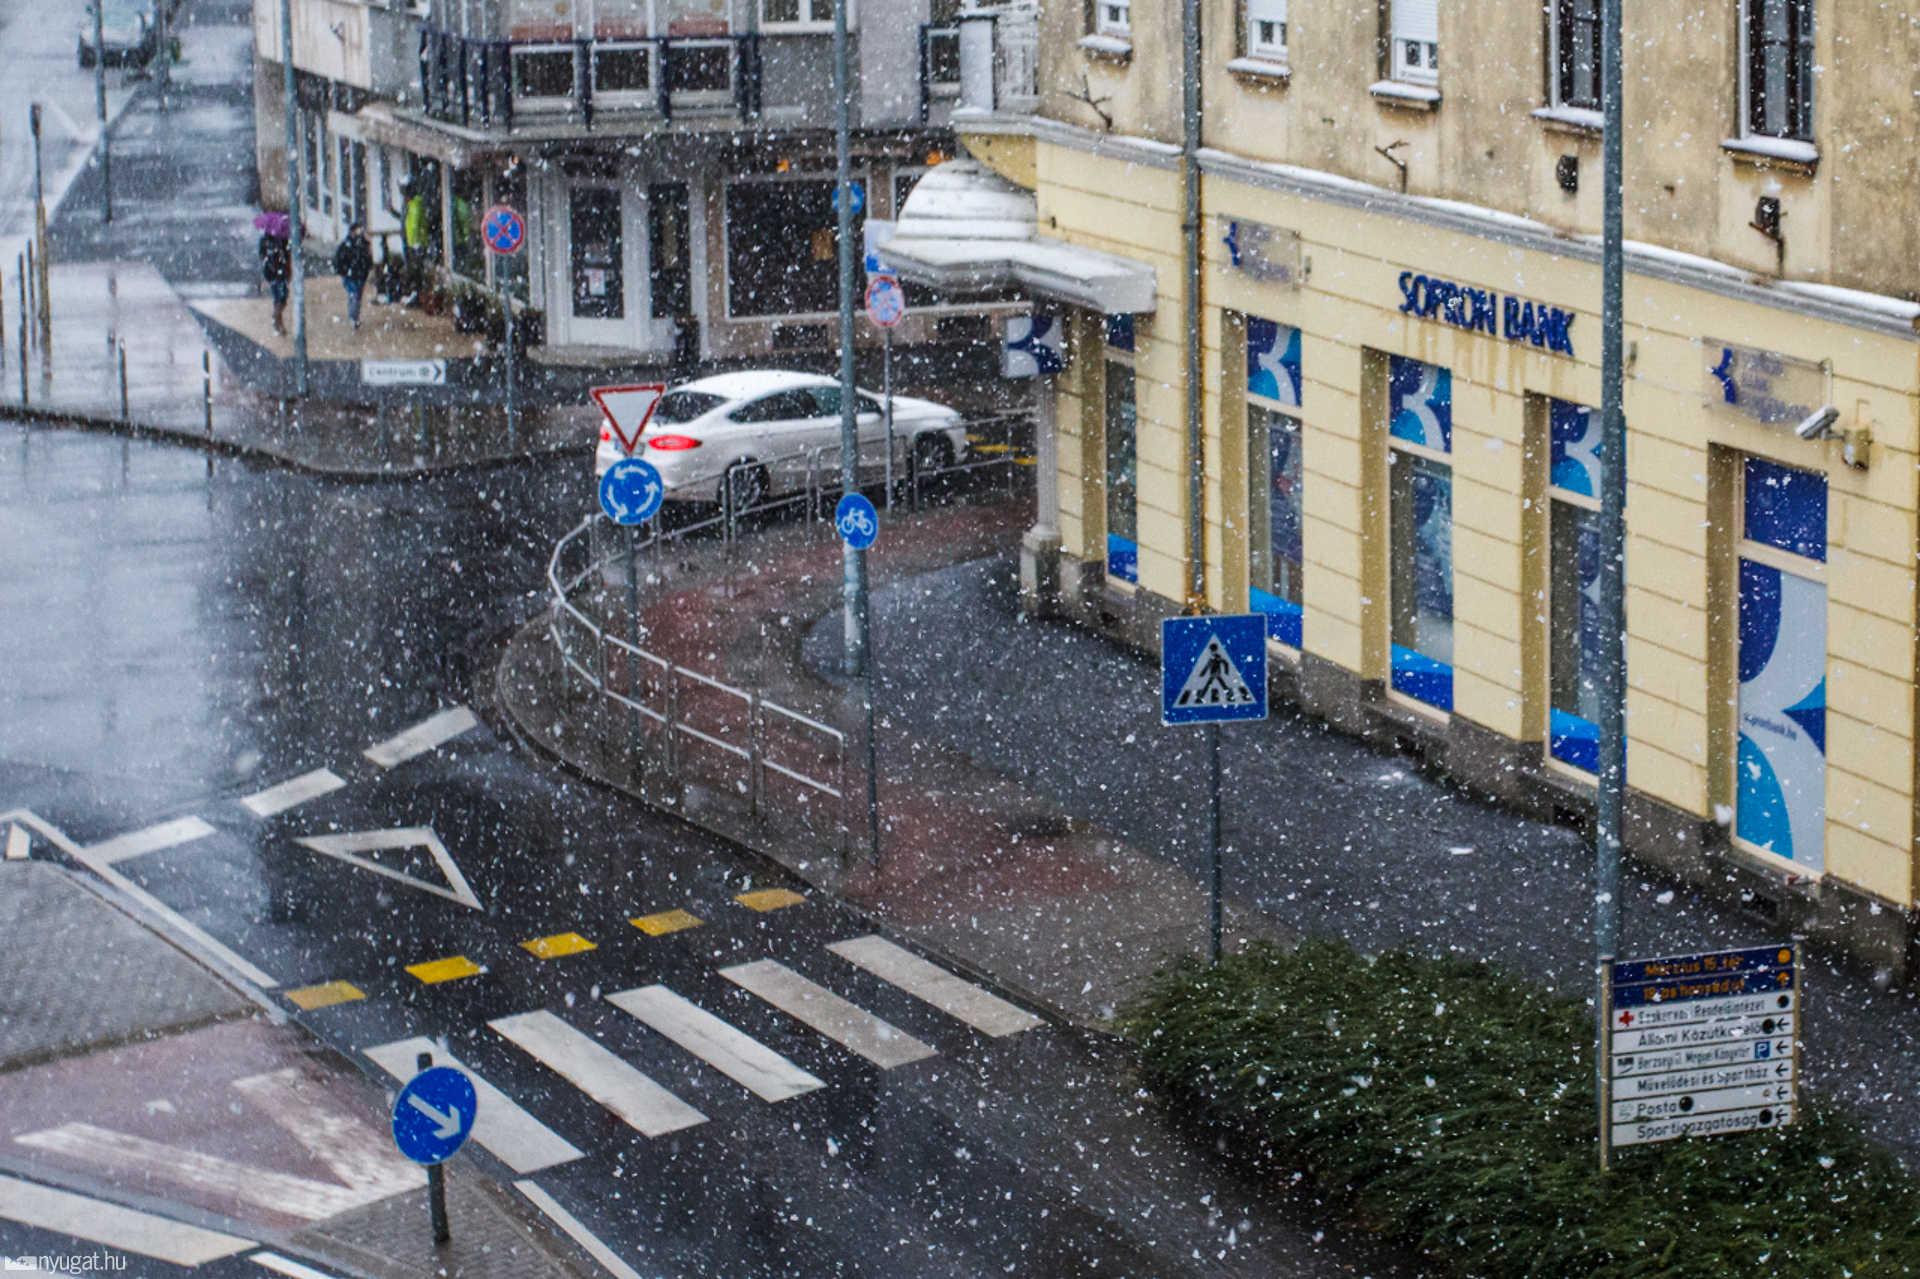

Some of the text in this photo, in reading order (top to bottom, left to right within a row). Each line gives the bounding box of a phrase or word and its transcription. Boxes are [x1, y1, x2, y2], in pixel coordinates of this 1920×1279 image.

[1398, 271, 1576, 357] SOPRON BANK
[1638, 1101, 1677, 1116] Posta
